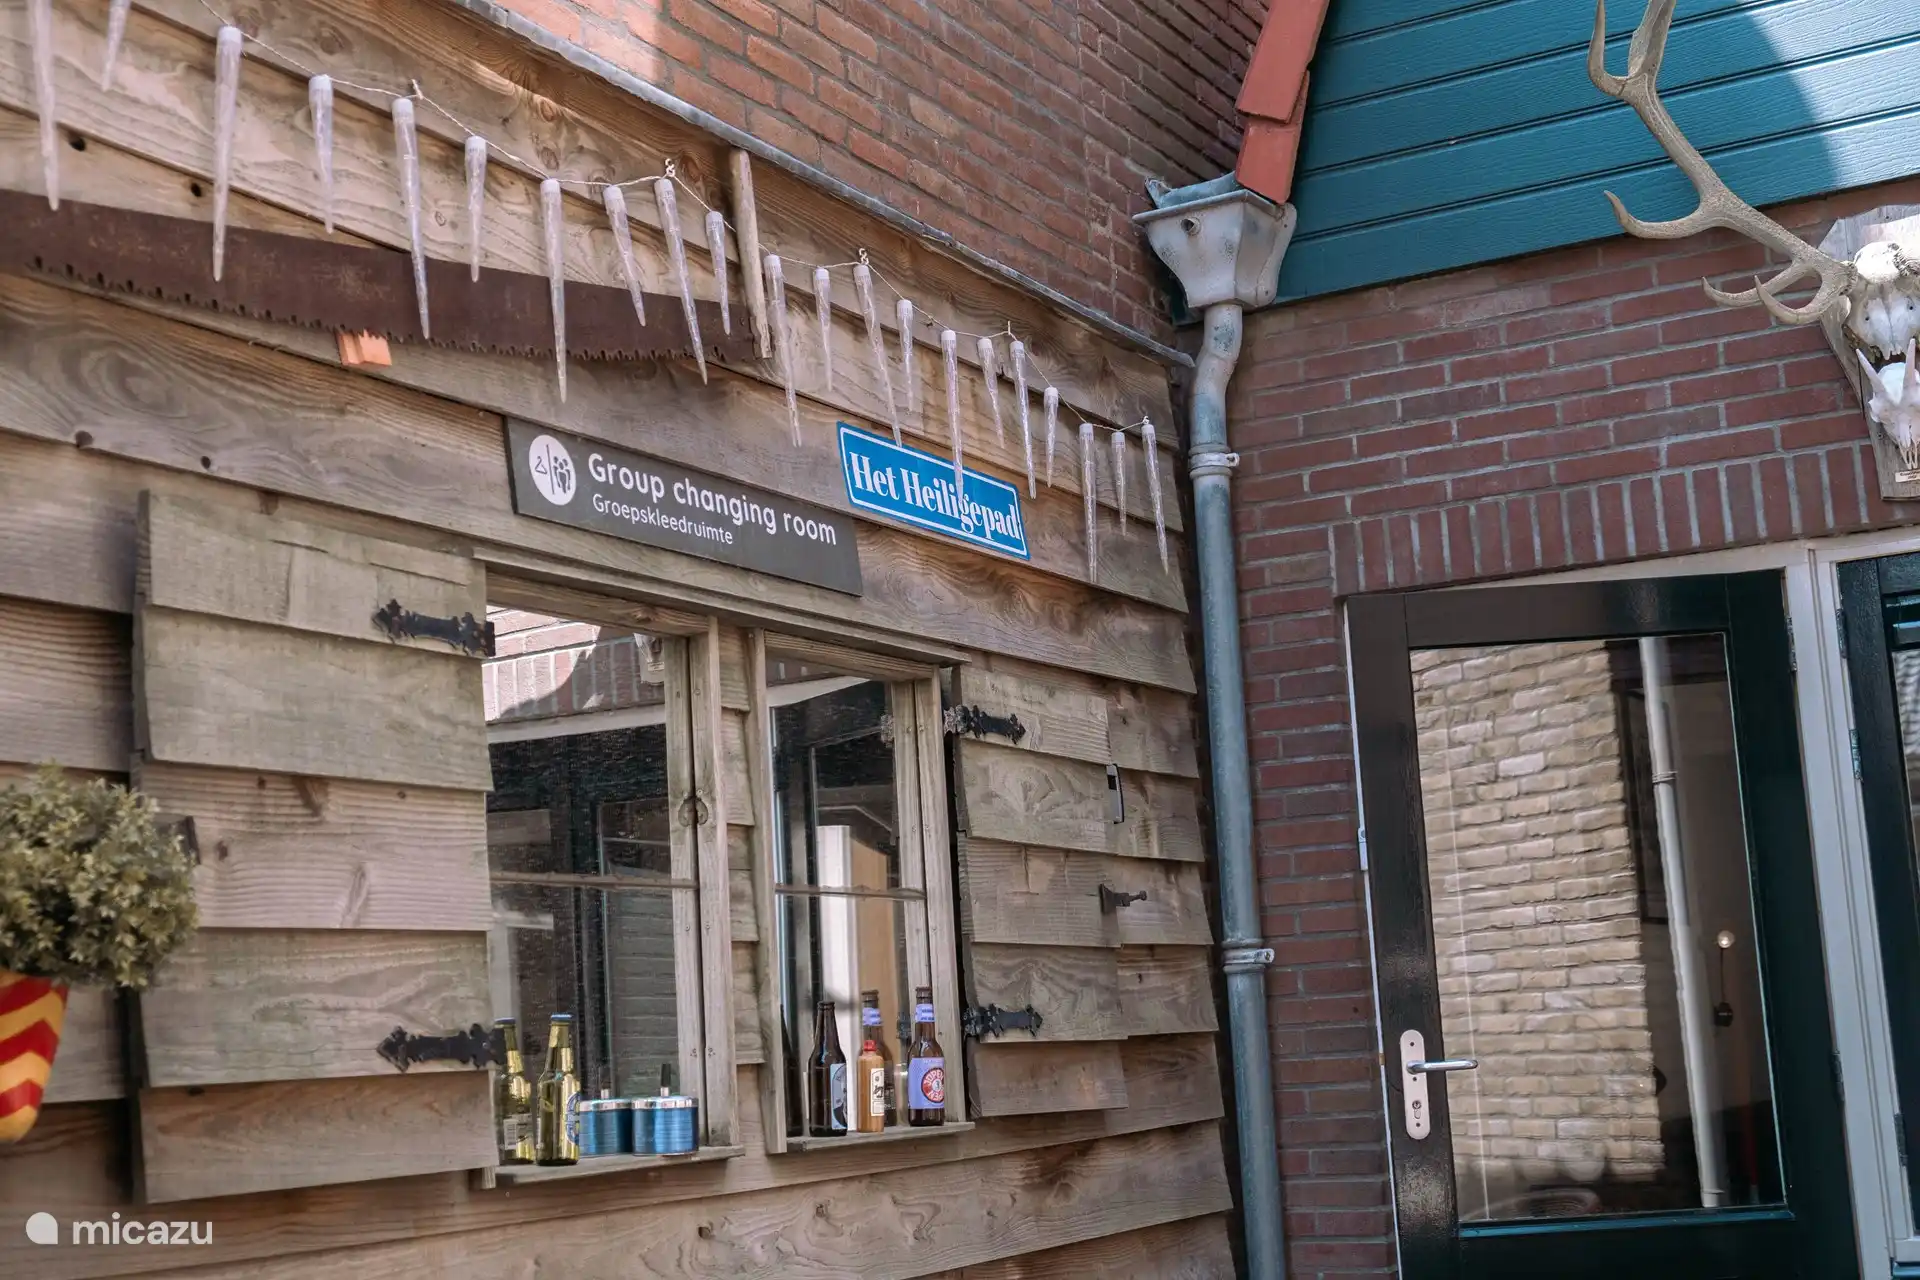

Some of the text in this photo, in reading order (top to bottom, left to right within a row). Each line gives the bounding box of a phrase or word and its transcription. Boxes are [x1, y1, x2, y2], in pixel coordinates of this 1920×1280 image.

[588, 453, 837, 545] Group changing room
[592, 493, 733, 544] Groepskleedruimte
[849, 452, 1021, 541] Het Heiligepad
